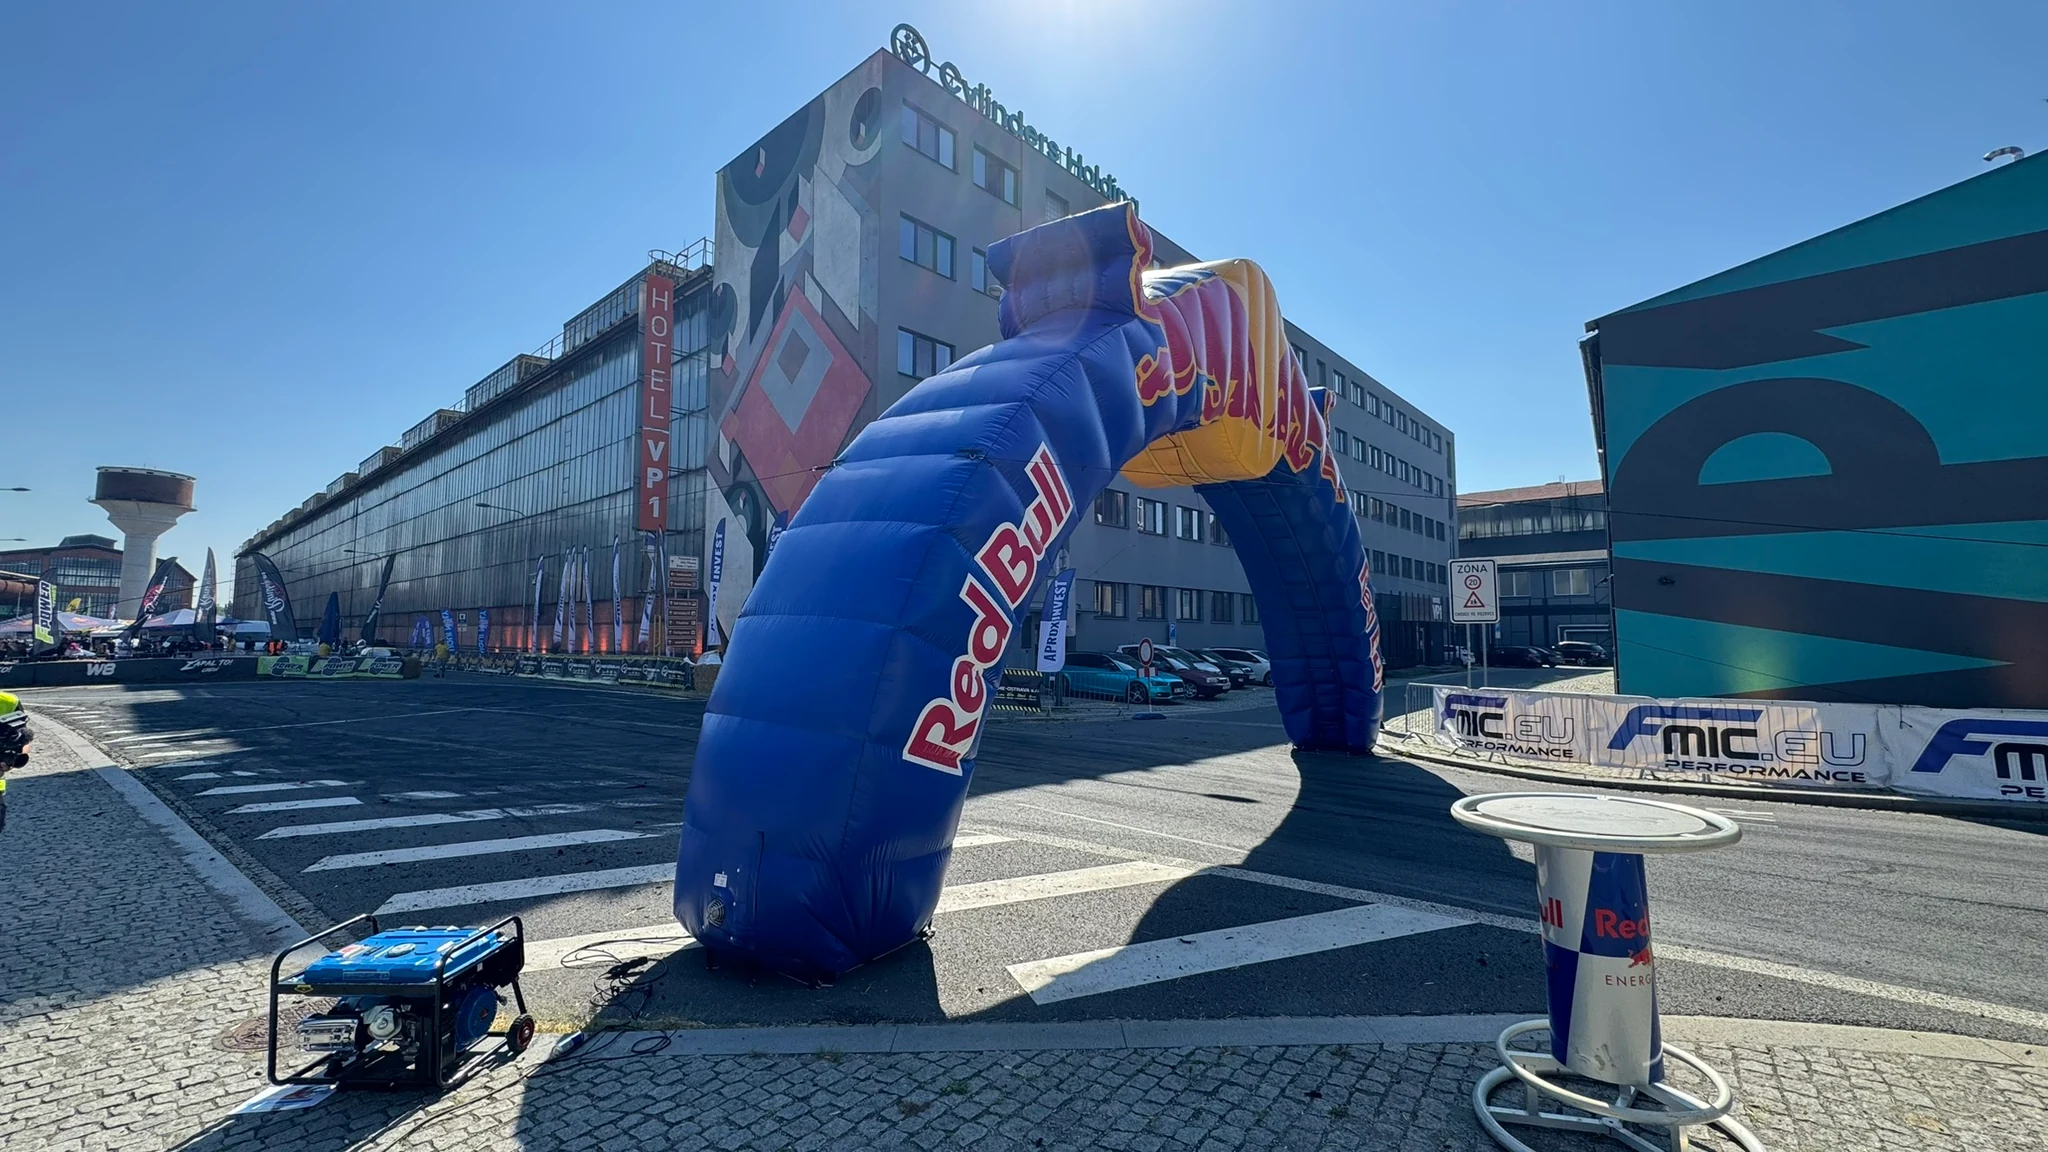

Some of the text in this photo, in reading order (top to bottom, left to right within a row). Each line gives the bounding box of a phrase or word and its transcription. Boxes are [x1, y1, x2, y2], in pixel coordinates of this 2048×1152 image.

[939, 61, 1060, 161] Cylinders
[646, 287, 668, 518] HOTEL VP1
[1457, 563, 1488, 573] ZÓNA
[903, 573, 1012, 776] Red
[974, 441, 1073, 610] Bull
[87, 663, 115, 676] W8
[180, 658, 234, 671] ZAPAL TO!
[1460, 739, 1574, 758] RFORMANCE
[1665, 760, 1866, 782] PERFORMANCE
[2000, 785, 2048, 799] PE
[1540, 897, 1563, 929] ull
[1594, 906, 1650, 939] Red
[1605, 975, 1652, 987] ENERG
